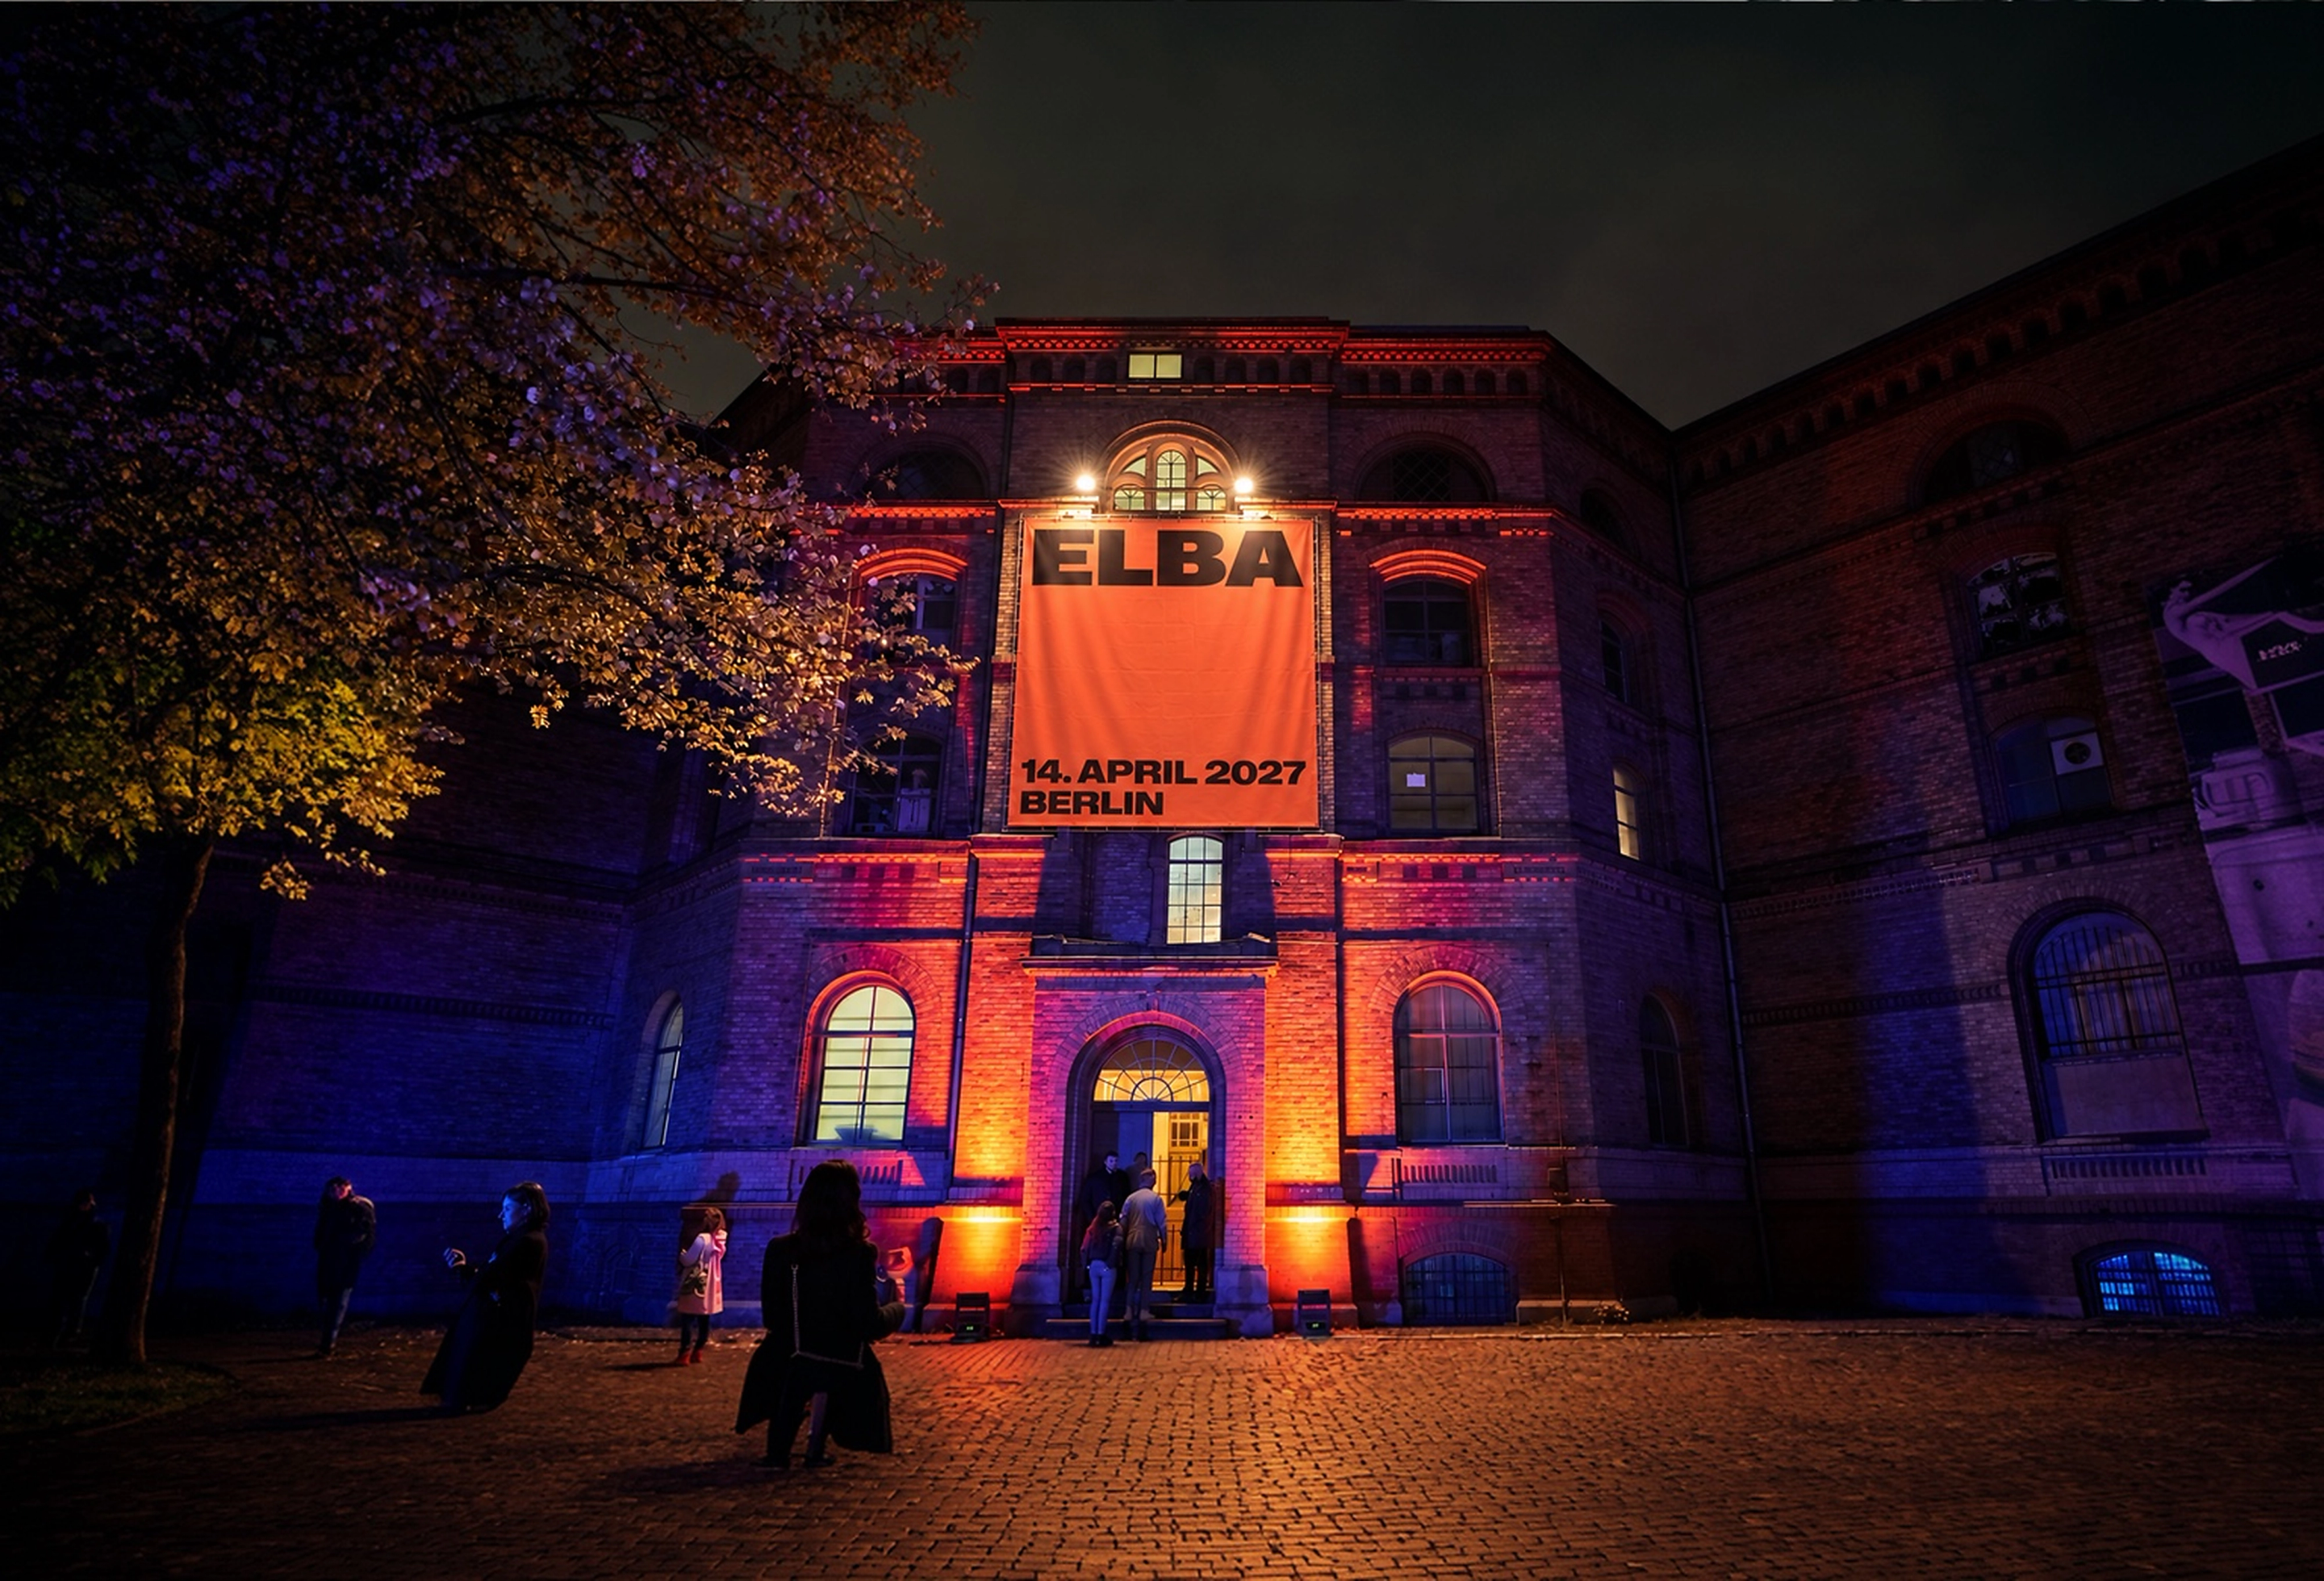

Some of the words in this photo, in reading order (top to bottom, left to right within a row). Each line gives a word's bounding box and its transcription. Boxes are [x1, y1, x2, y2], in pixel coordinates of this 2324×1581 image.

[1031, 529, 1304, 588] ELBA
[1021, 759, 1072, 784] 14.
[1076, 759, 1198, 784] APRIL
[1205, 759, 1306, 786] 2027
[1019, 790, 1164, 816] BERLIN
